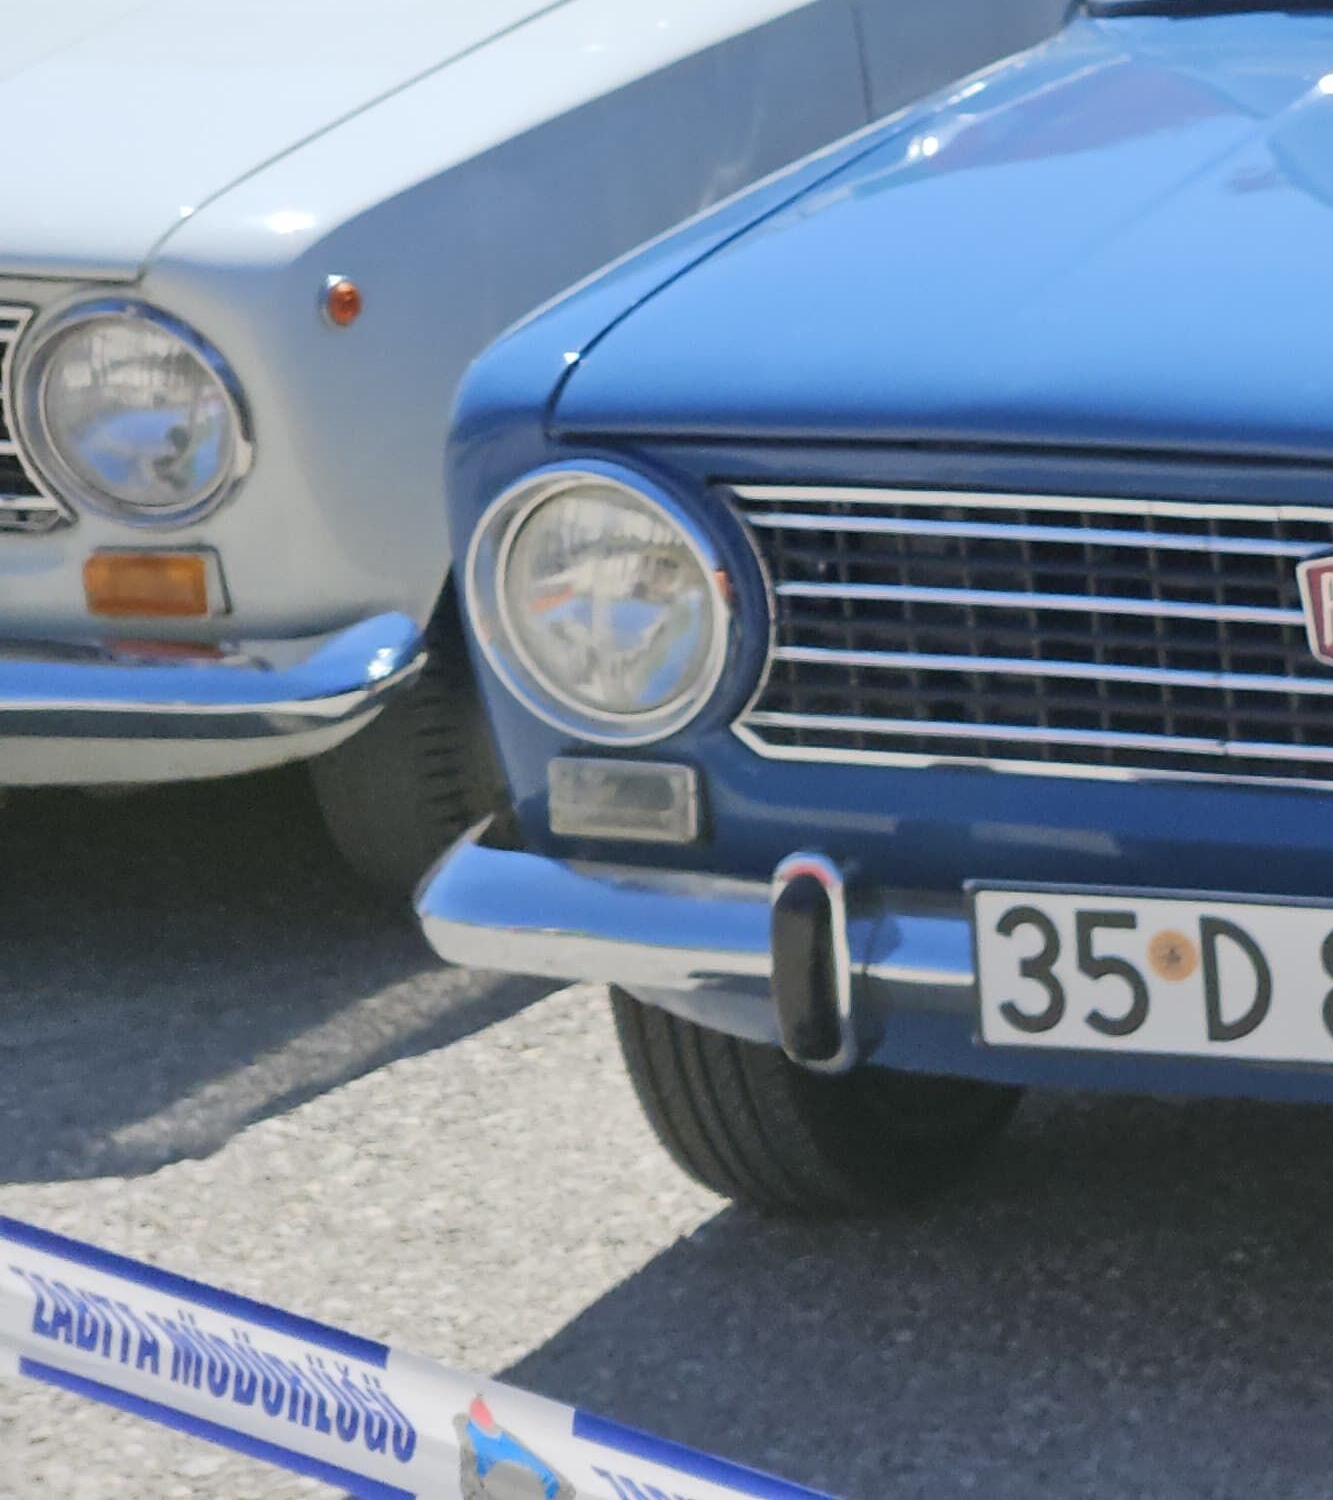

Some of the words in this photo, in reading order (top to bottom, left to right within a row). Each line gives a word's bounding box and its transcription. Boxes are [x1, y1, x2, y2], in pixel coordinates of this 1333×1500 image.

[996, 906, 1150, 1036] 35
[1200, 916, 1272, 1041] D
[8, 1264, 160, 1375] ZABITA
